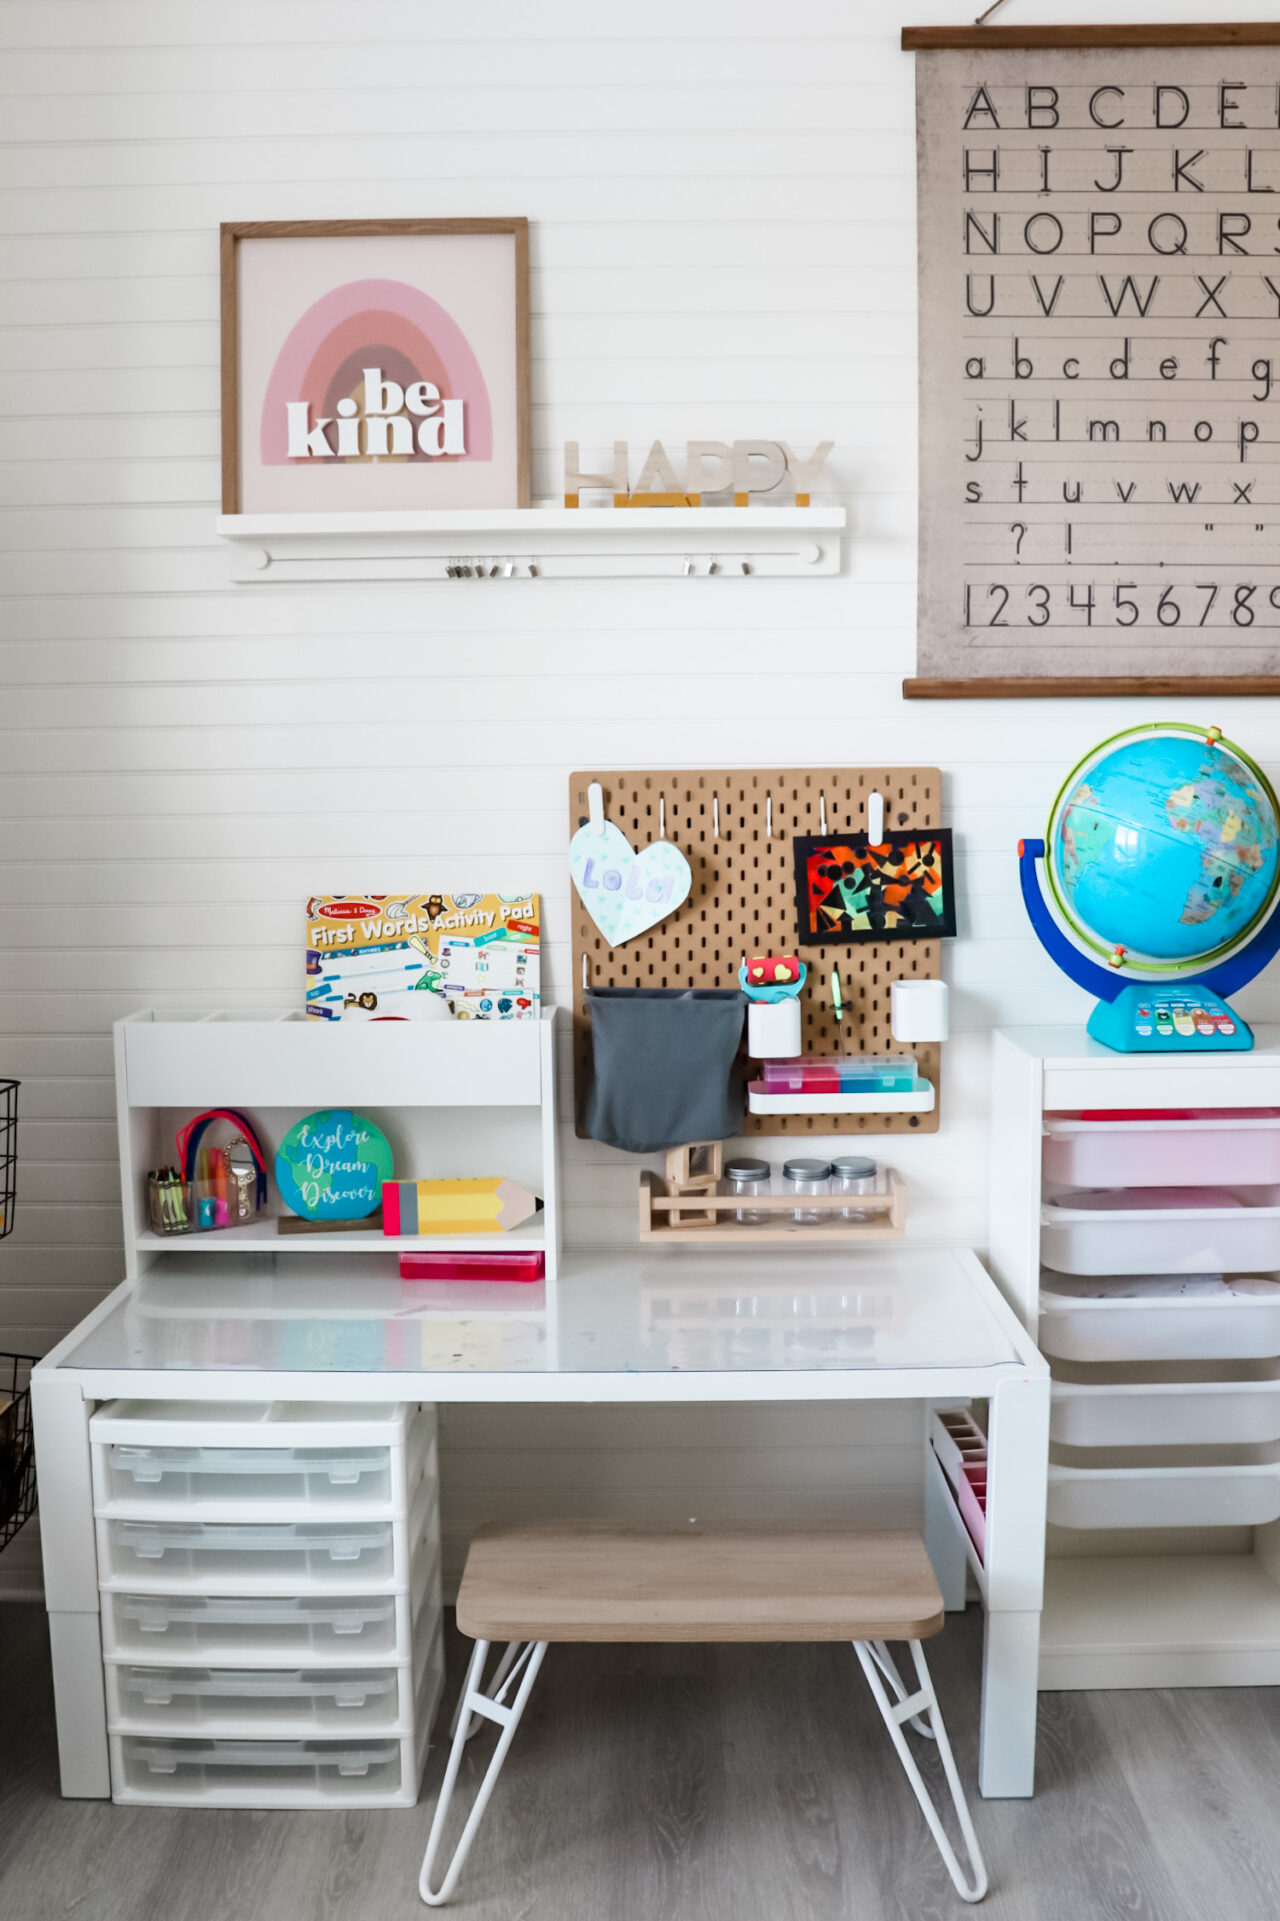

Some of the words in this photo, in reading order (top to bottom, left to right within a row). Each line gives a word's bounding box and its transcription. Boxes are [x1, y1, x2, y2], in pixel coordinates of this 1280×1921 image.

[963, 85, 1000, 129] A
[1028, 86, 1059, 129] B
[1089, 86, 1124, 128] C
[1155, 86, 1189, 128] D
[1220, 86, 1246, 128] E
[965, 150, 997, 191] H
[1040, 150, 1052, 191] I
[1094, 150, 1133, 191] J
[1175, 150, 1204, 191] K
[1248, 150, 1274, 191] L
[966, 212, 997, 254] N
[1025, 212, 1062, 254] O
[1091, 212, 1121, 254] P
[1148, 212, 1187, 254] Q
[1219, 213, 1250, 254] R
[967, 275, 994, 316] U
[1032, 275, 1062, 316] V
[1100, 275, 1158, 316] W
[1196, 276, 1226, 317] X
[965, 358, 983, 379] a
[1014, 338, 1032, 379] b
[1063, 358, 1079, 379] c
[1110, 338, 1128, 379] d
[1160, 358, 1177, 379] e
[1207, 338, 1227, 379] f
[1252, 359, 1270, 401] g
[363, 368, 441, 416] be
[287, 398, 466, 458] kind
[965, 405, 982, 461] j
[1011, 400, 1027, 441] k
[1056, 400, 1059, 441] l
[1089, 421, 1119, 441] m
[1149, 421, 1165, 441] n
[1194, 421, 1212, 442] o
[1240, 421, 1259, 462] p
[565, 441, 834, 509] HAPPY
[966, 482, 981, 503] s
[1014, 462, 1027, 502] t
[1064, 482, 1079, 502] u
[1117, 483, 1134, 502] v
[1170, 483, 1198, 503] w
[1234, 483, 1251, 503] x
[1011, 523, 1027, 564] ?
[311, 924, 355, 947] First
[361, 914, 429, 940] Words
[434, 909, 495, 931] Activity
[500, 902, 534, 920] Pad
[297, 1124, 370, 1153] Explore
[298, 1153, 370, 1179] Dream
[294, 1182, 376, 1207] Discover
